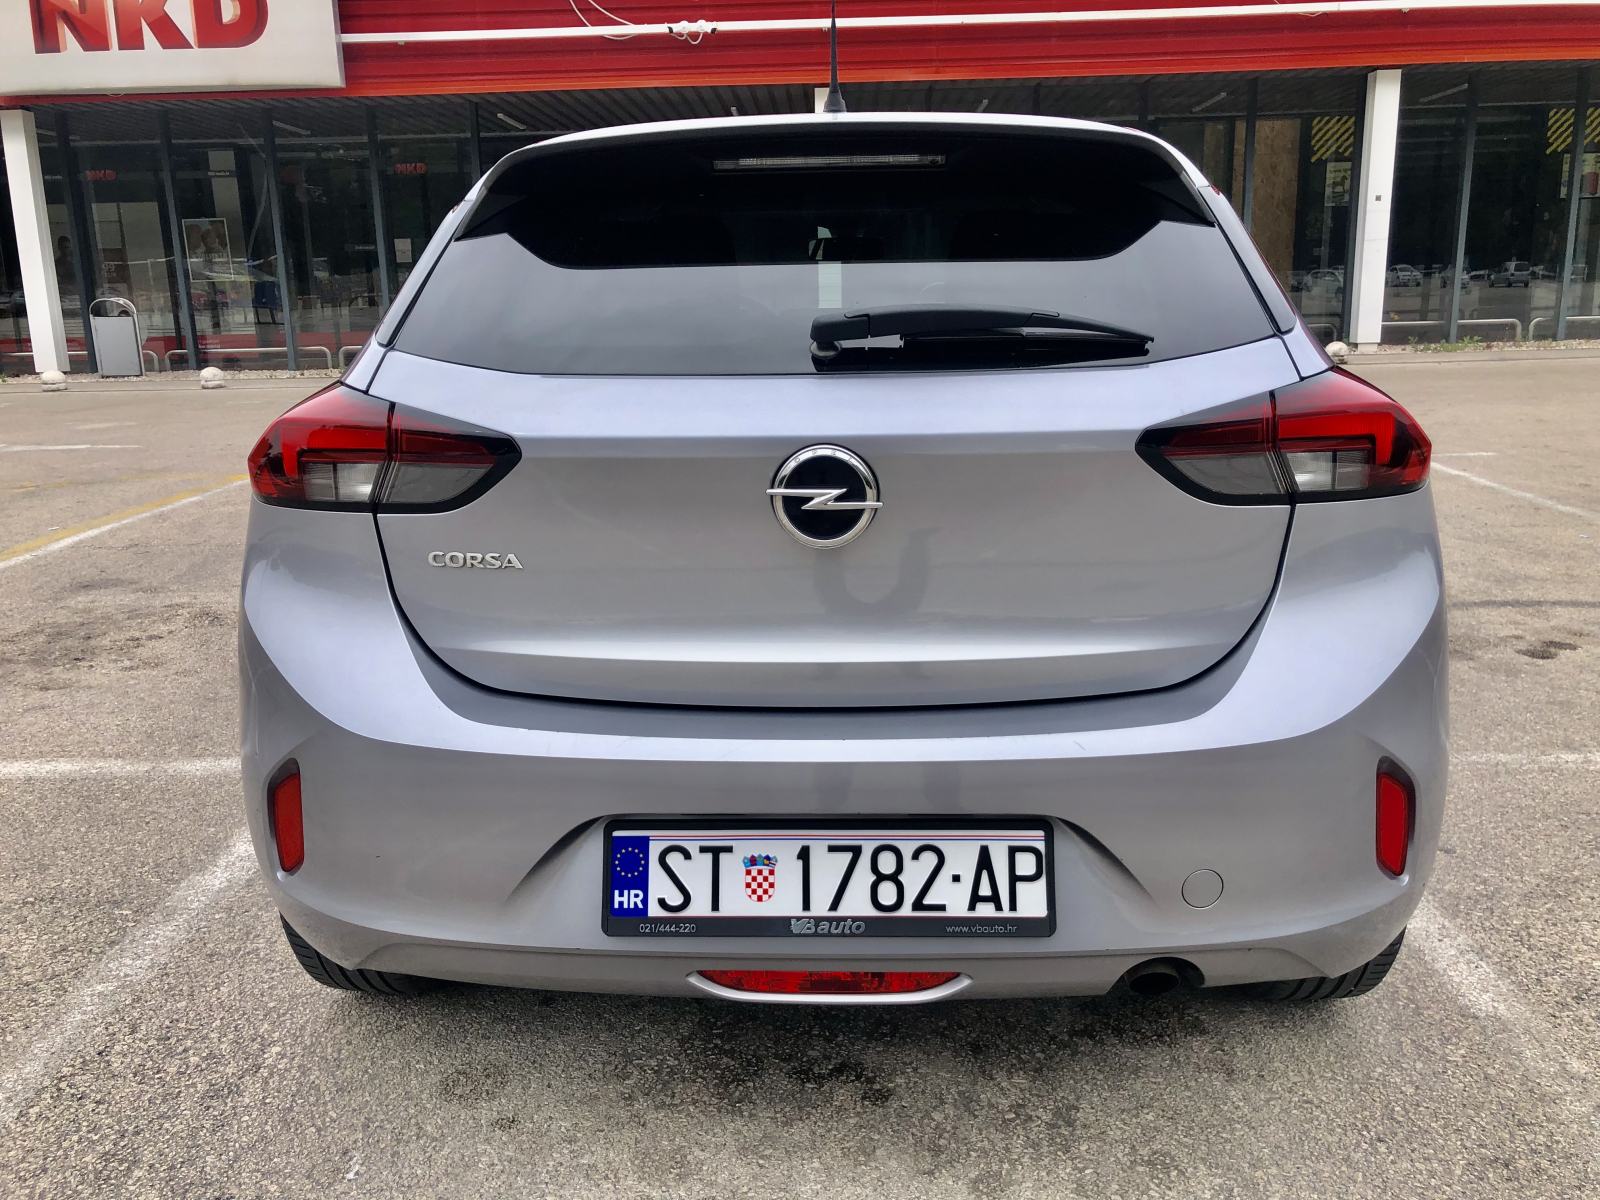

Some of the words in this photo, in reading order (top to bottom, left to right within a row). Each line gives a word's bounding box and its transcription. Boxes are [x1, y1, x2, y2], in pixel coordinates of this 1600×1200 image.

[29, 0, 268, 54] NKD
[428, 551, 523, 569] CORSA
[657, 844, 733, 913] ST
[614, 889, 644, 909] HR
[639, 923, 697, 934] 021/444-220
[945, 923, 1018, 934] www.vbauto.hr
